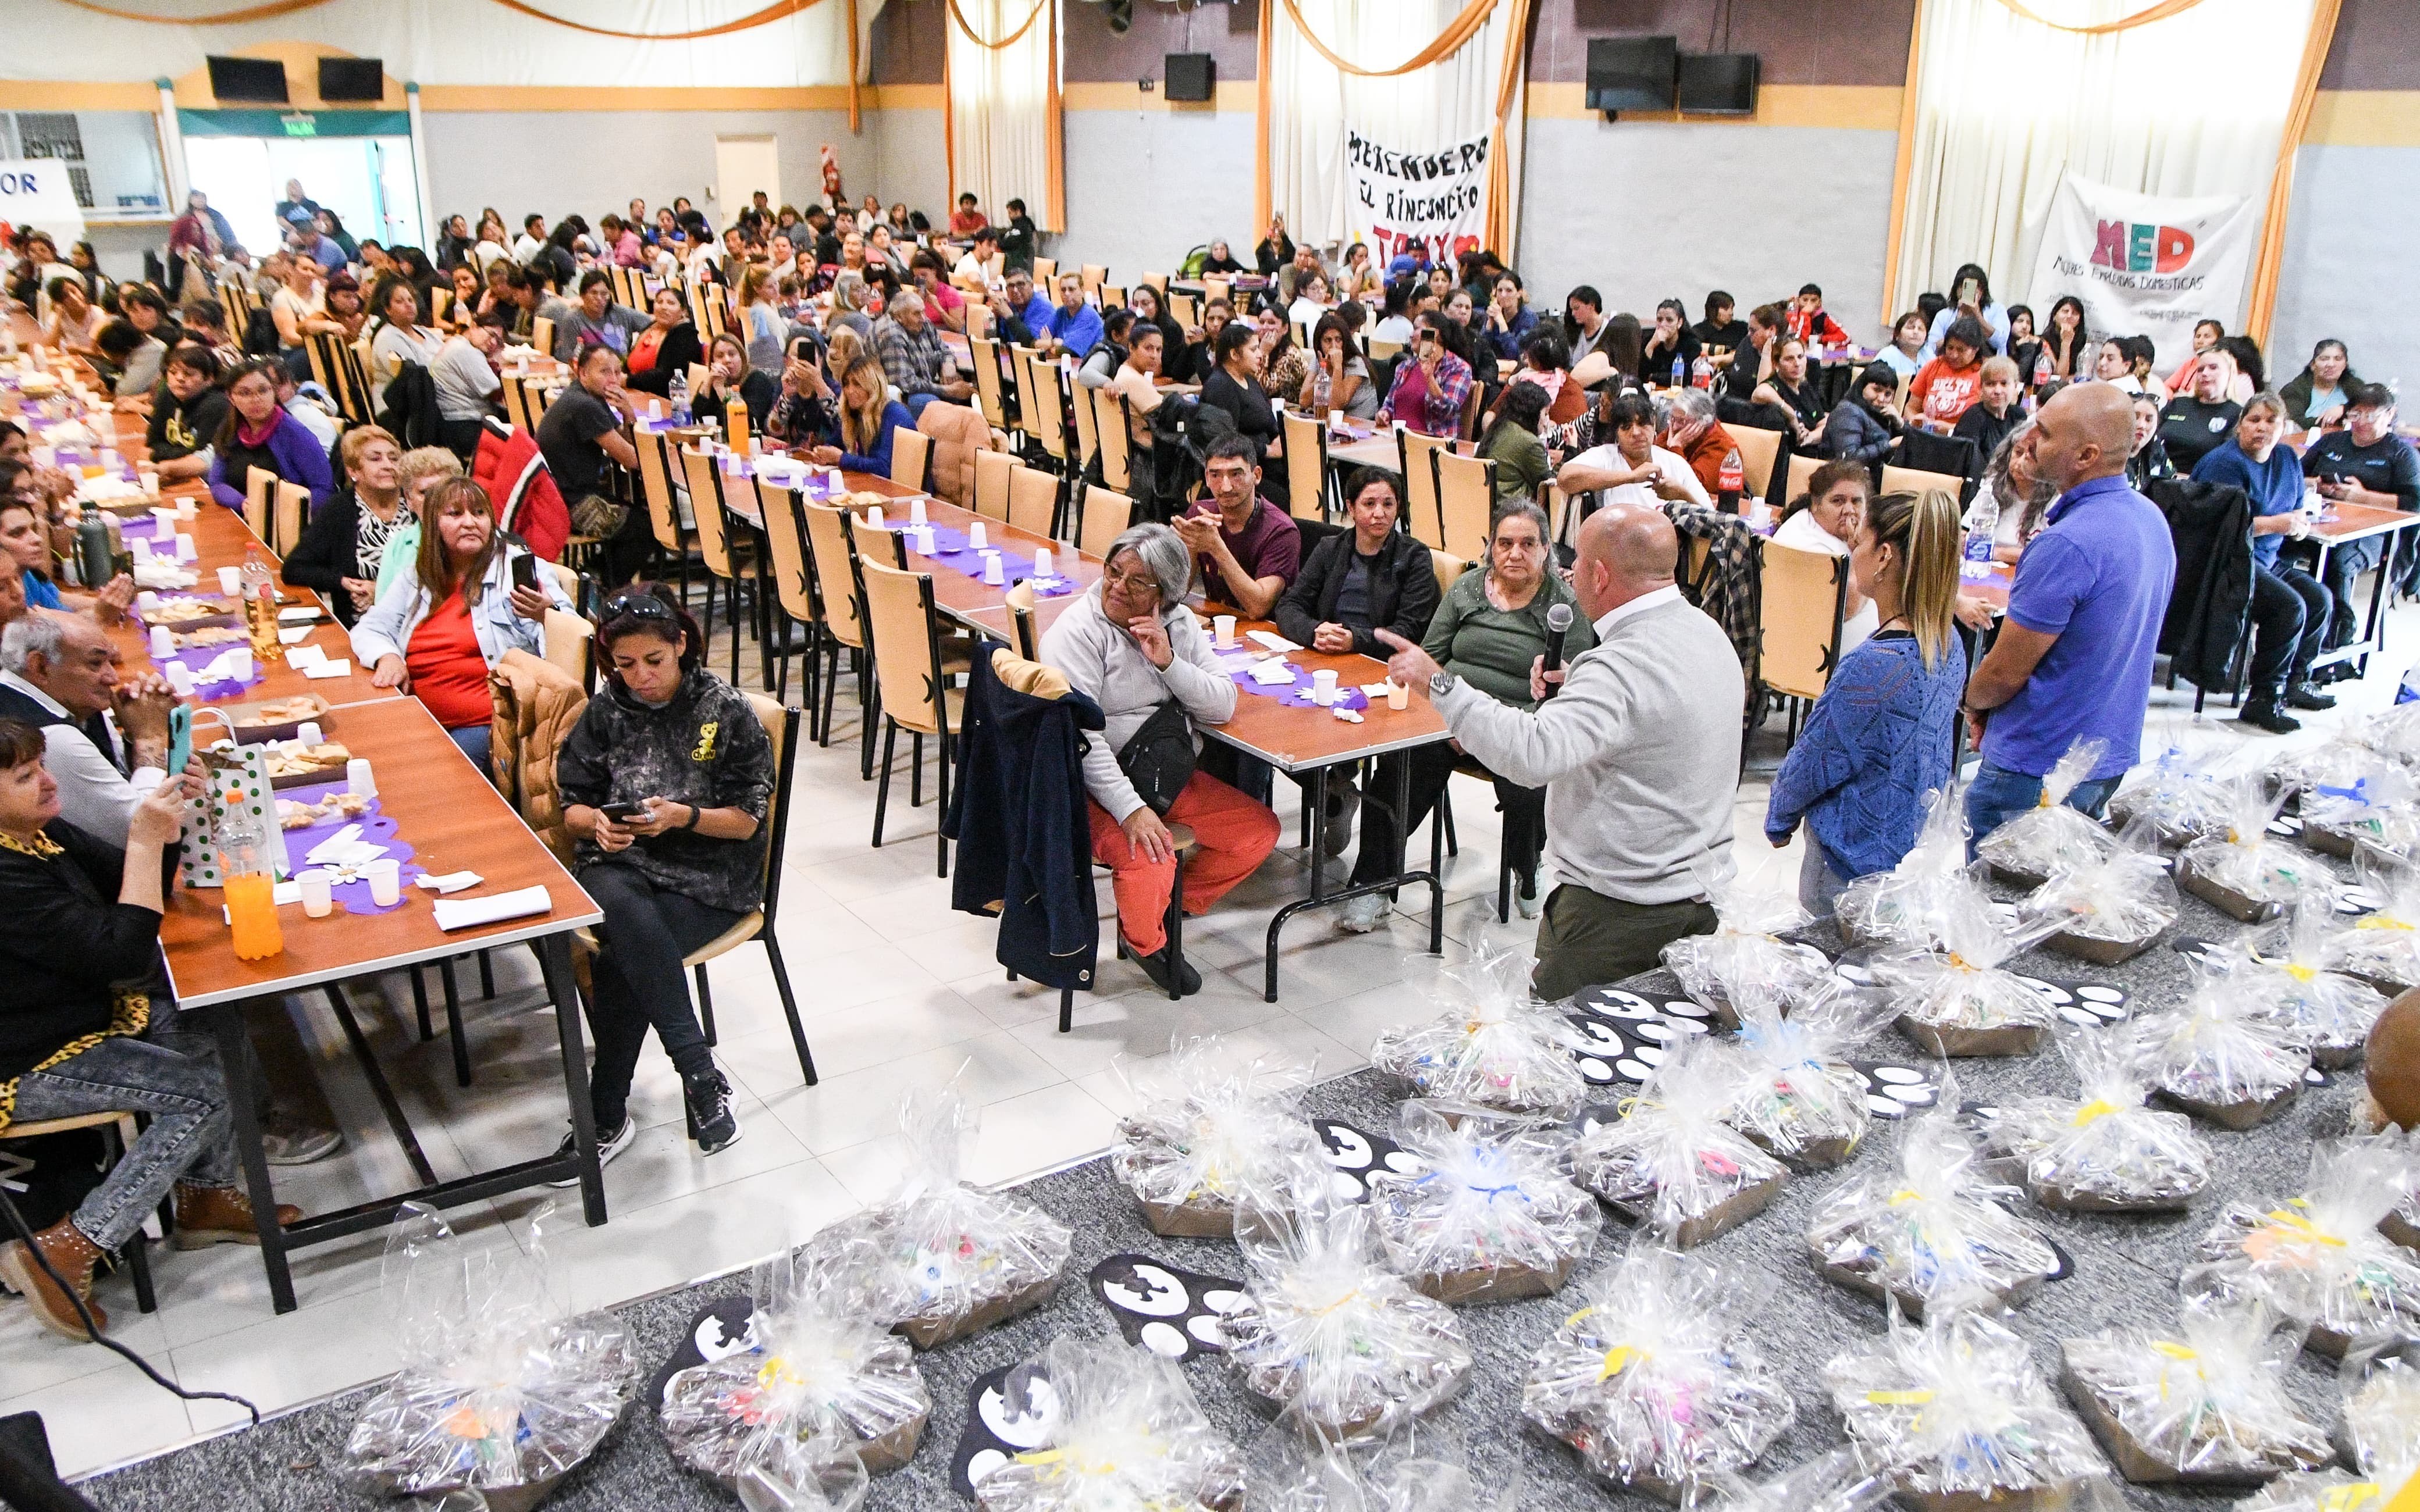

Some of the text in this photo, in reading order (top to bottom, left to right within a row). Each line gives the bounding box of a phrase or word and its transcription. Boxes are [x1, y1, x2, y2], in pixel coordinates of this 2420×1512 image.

[1348, 130, 1489, 181] MERENDERO
[0, 173, 37, 195] OR
[1360, 178, 1375, 209] EL
[1373, 224, 1450, 269] TOY
[2089, 219, 2195, 273] MED
[2140, 274, 2205, 291] DOMESTICAS
